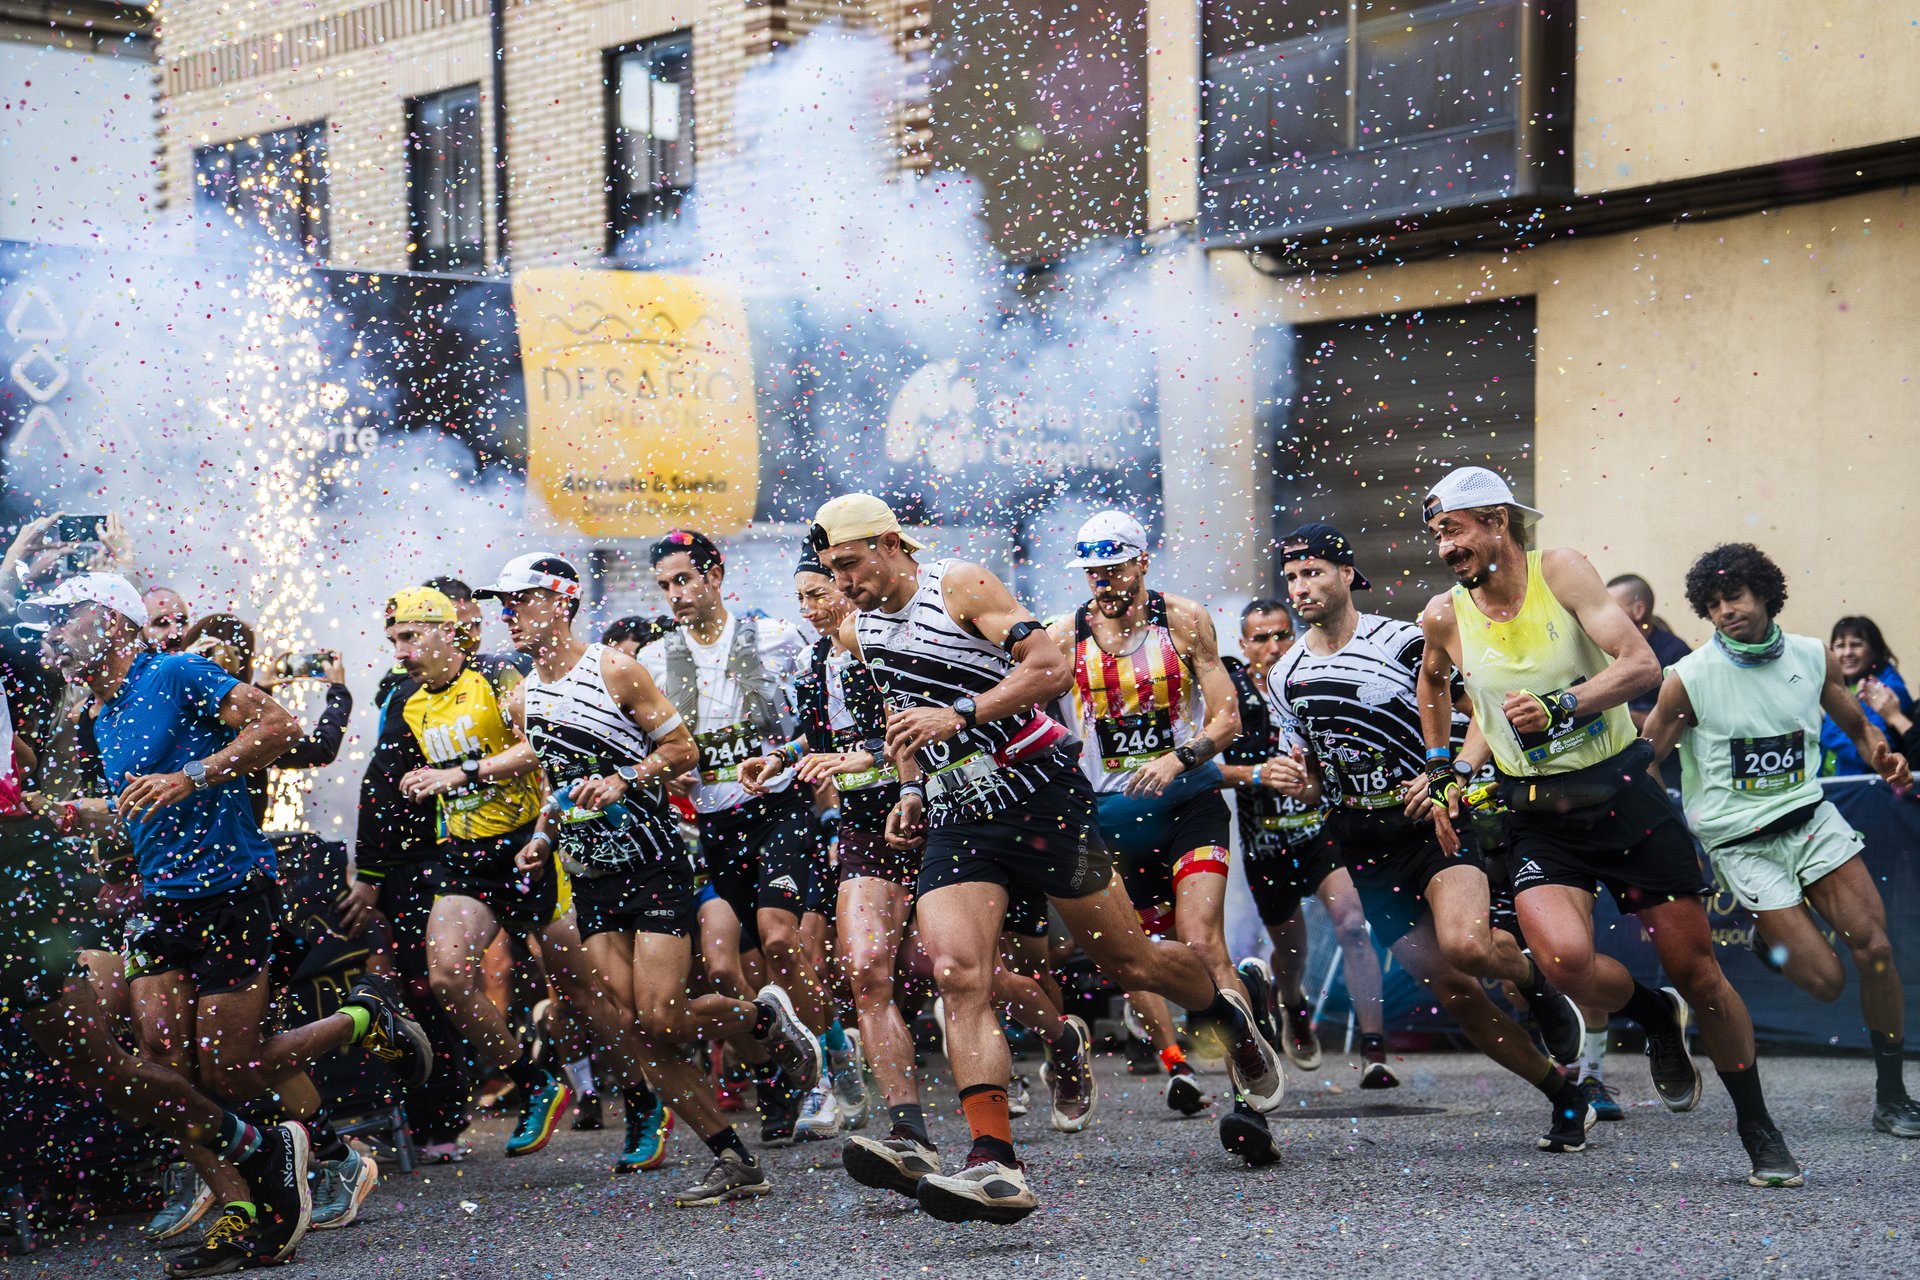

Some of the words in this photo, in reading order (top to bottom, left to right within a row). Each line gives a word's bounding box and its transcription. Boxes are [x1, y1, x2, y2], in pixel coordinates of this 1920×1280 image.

[704, 738, 749, 767] 244
[1113, 727, 1158, 753] 246
[1744, 748, 1794, 774] 206
[1347, 771, 1388, 793] 178
